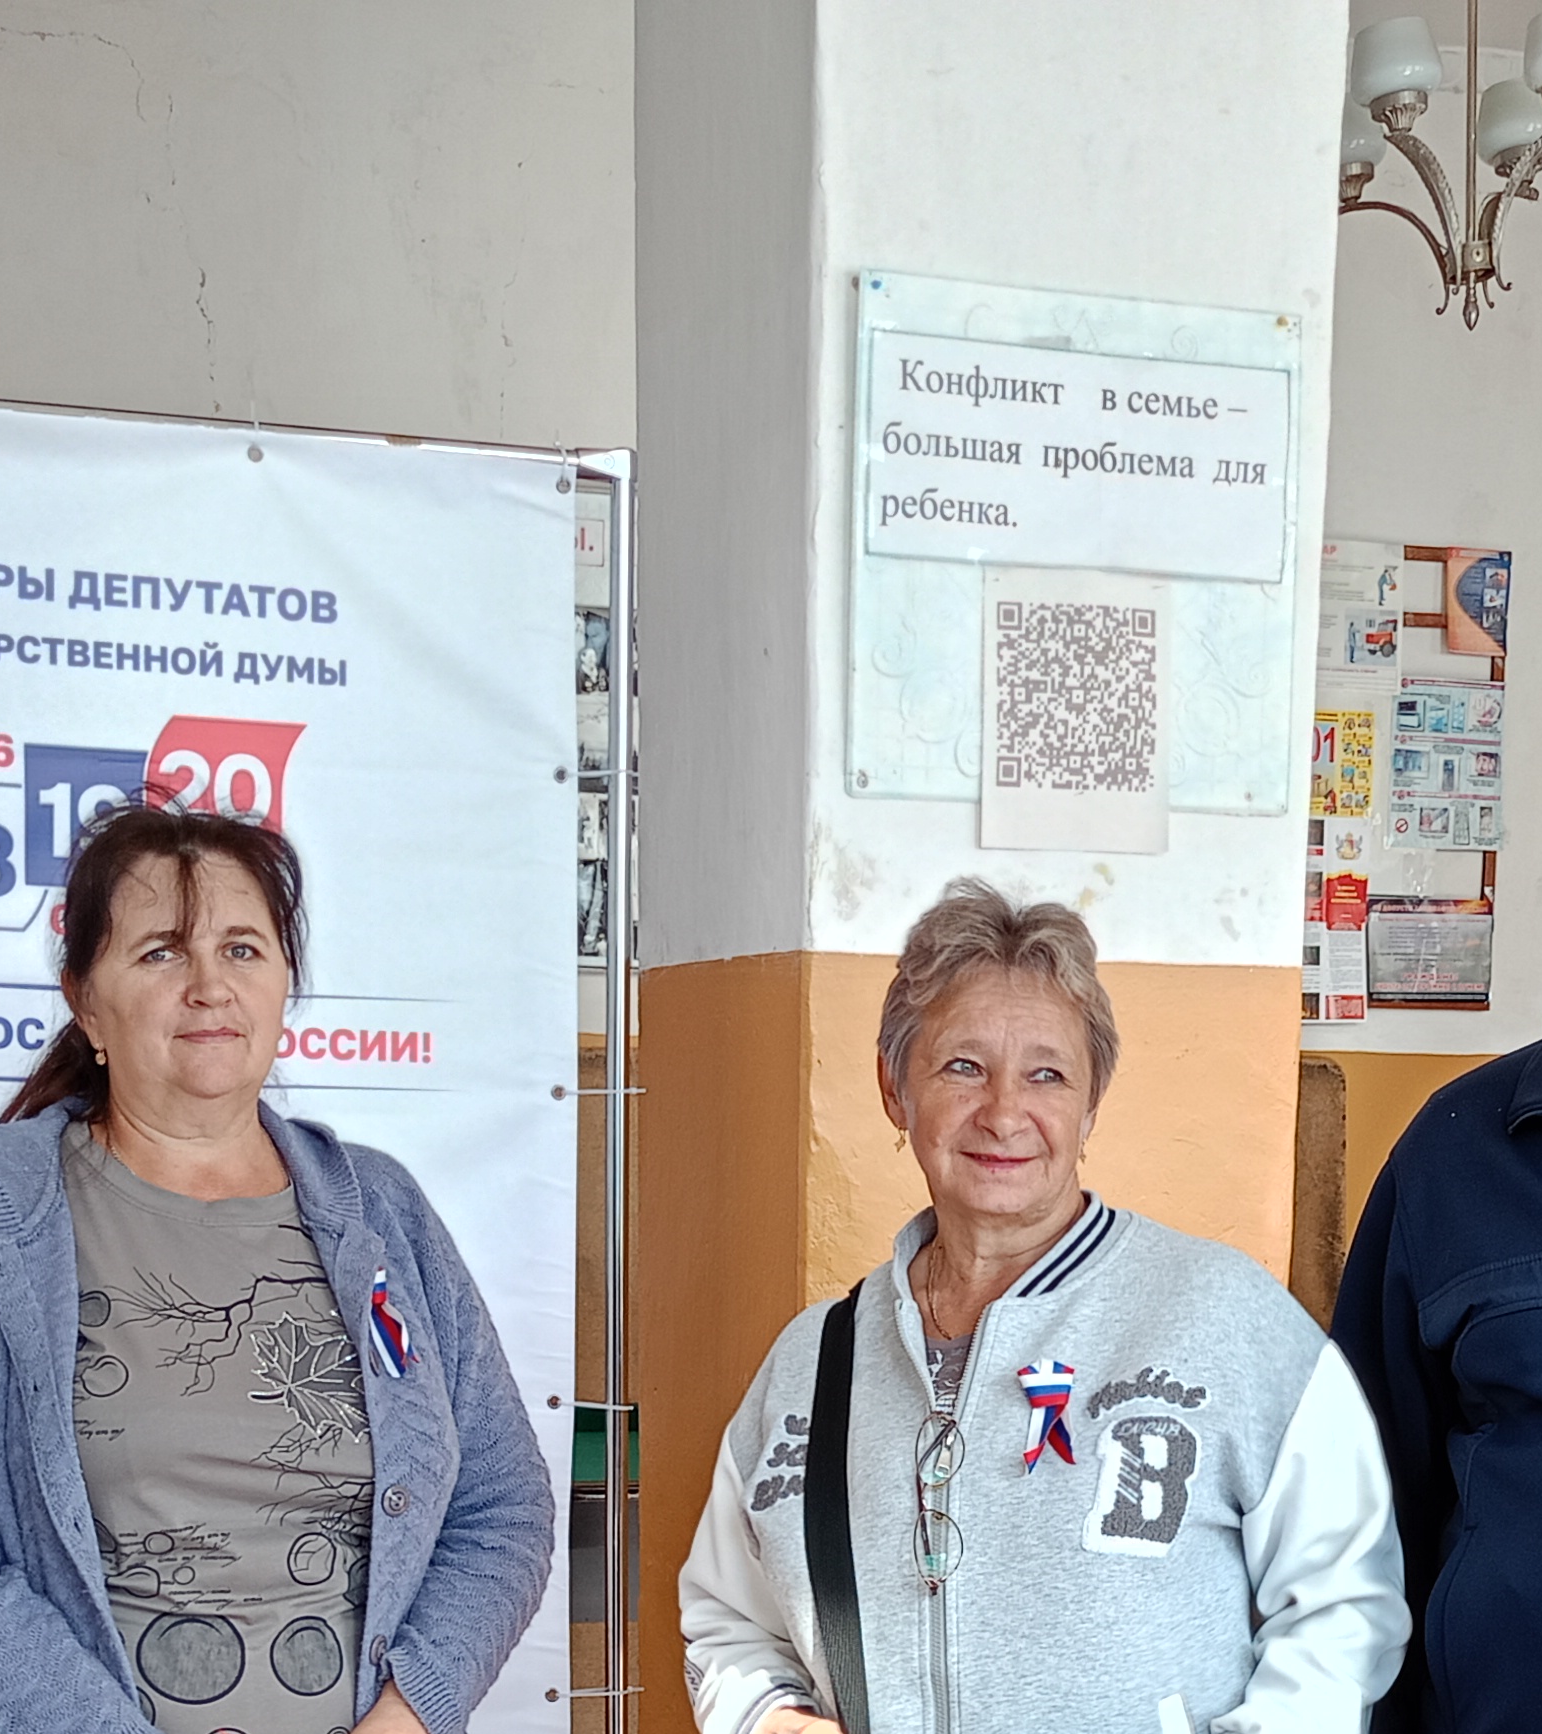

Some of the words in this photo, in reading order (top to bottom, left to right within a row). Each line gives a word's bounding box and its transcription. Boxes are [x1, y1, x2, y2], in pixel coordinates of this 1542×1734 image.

[899, 358, 1065, 408] Конфликт
[1101, 387, 1118, 411] в
[1127, 390, 1219, 420] семье
[882, 421, 1022, 466] большая
[1042, 441, 1195, 479] проблема
[1212, 457, 1267, 487] для
[879, 487, 1018, 528] ребенка.
[68, 570, 339, 625] ДЕПУТАТОВ
[233, 652, 348, 686] ДУМЫ
[159, 749, 272, 824] 20
[276, 1027, 431, 1064] ОССИИ!
